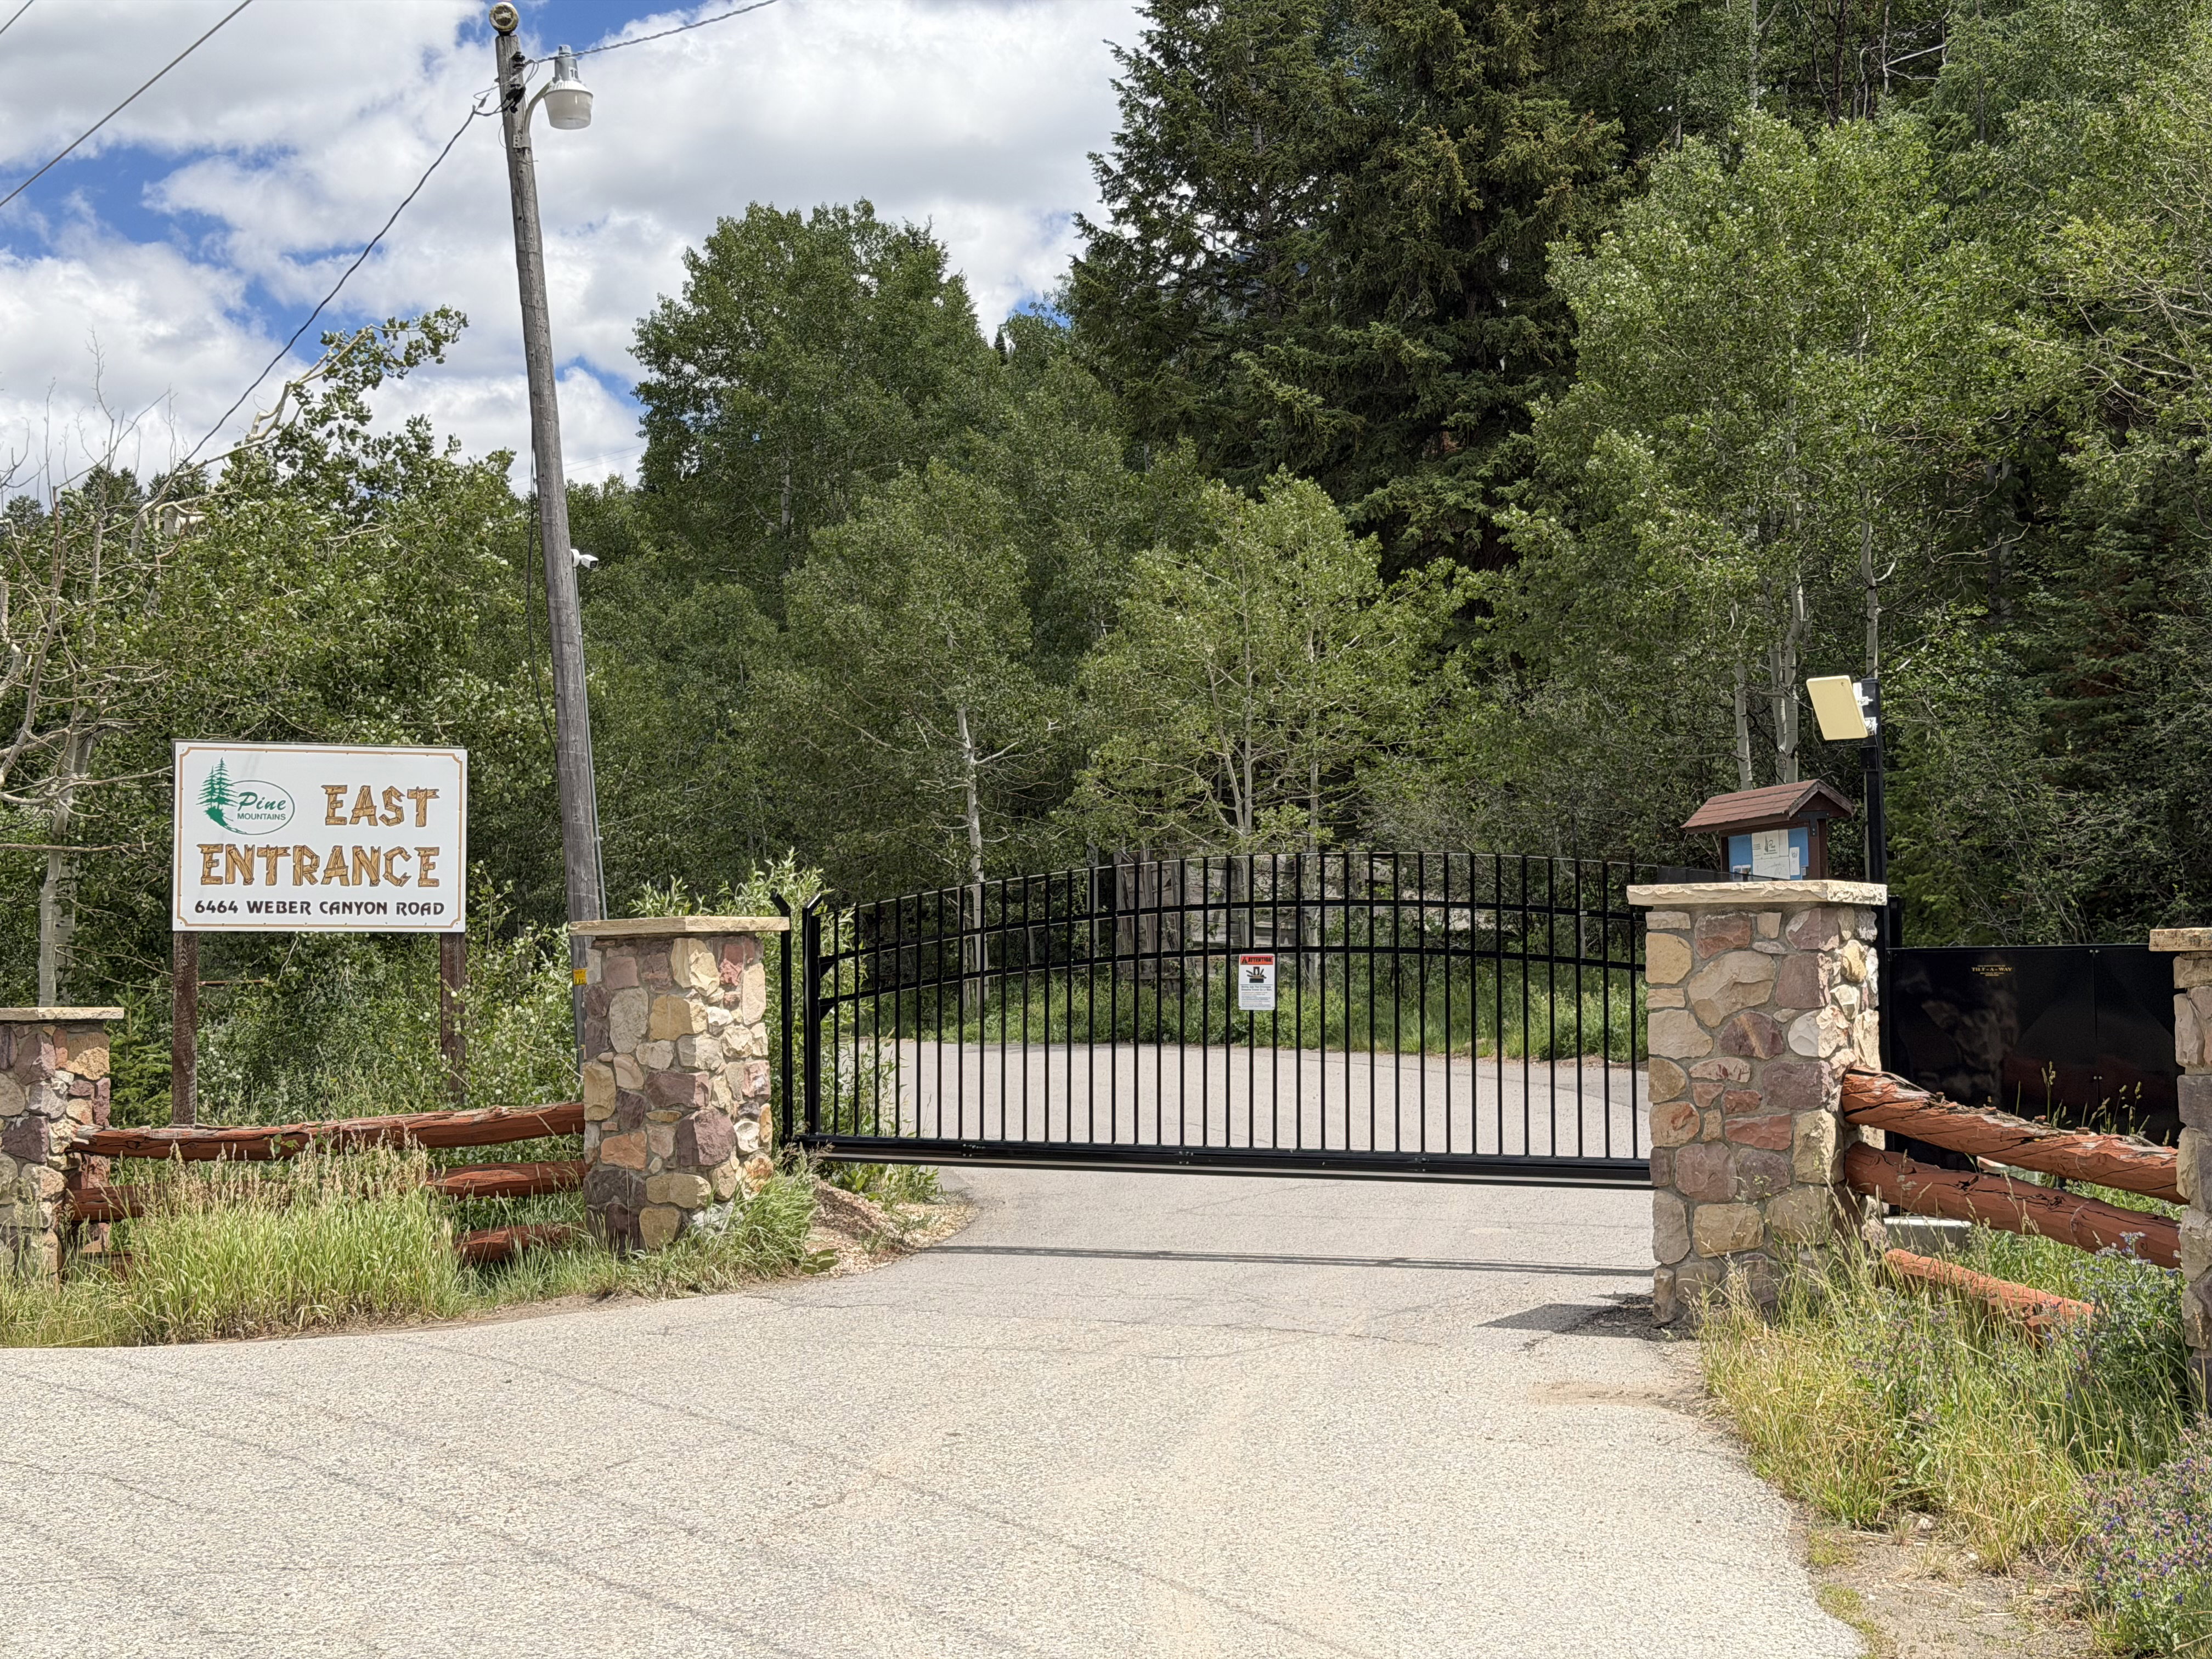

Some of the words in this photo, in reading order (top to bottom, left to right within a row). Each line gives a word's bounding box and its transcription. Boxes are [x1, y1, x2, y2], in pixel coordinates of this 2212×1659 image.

[238, 792, 286, 811] Pine
[321, 785, 440, 827] EAST
[196, 844, 440, 888] ENTRANCE
[195, 900, 239, 914] 6464
[246, 900, 312, 916] WEBER
[319, 901, 387, 916] CANYON
[396, 901, 445, 917] ROAD
